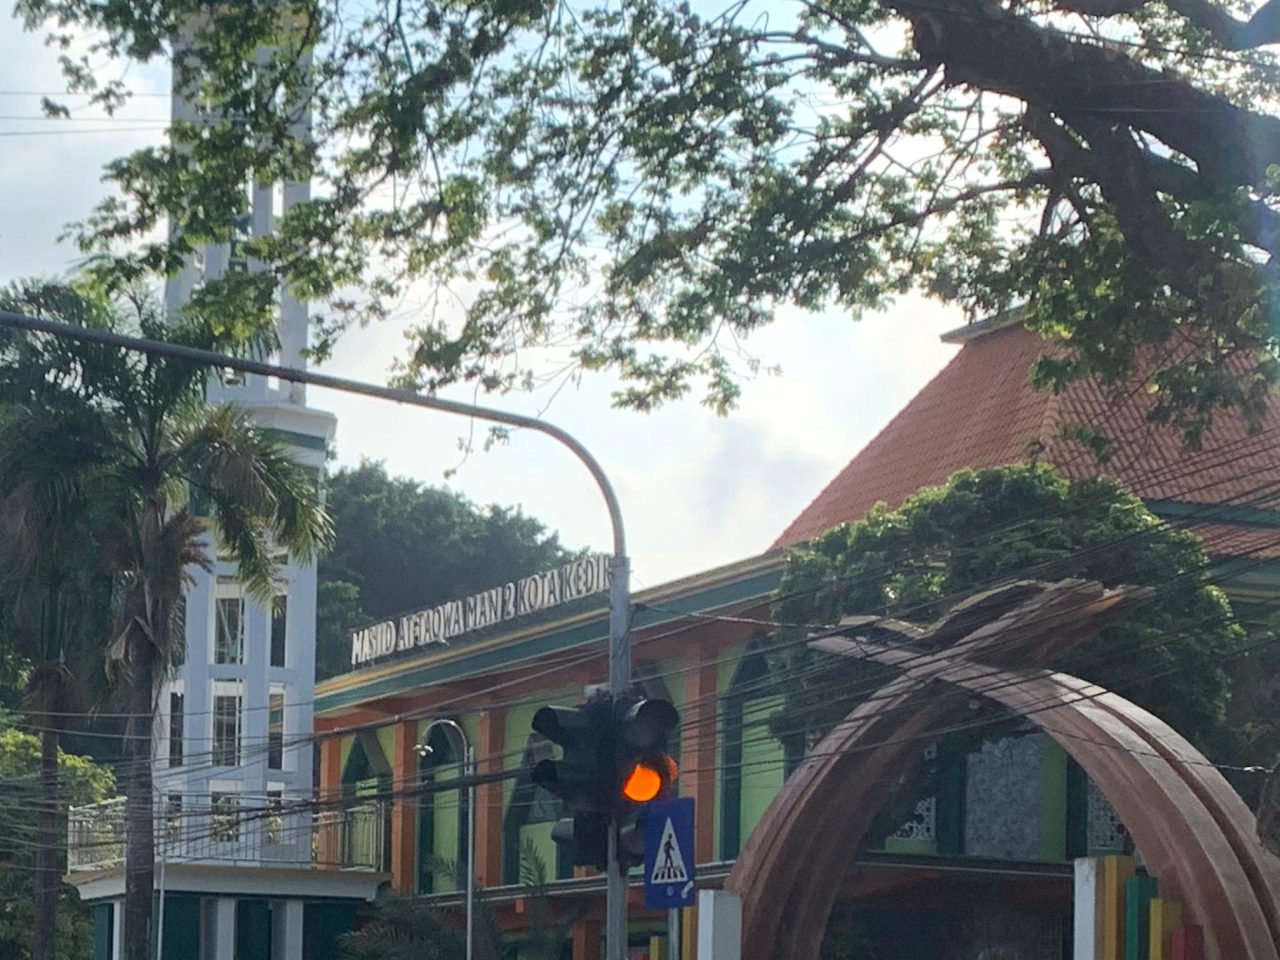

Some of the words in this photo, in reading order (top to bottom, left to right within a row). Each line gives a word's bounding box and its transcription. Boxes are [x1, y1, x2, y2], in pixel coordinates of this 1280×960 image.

[465, 586, 503, 632] MAN
[504, 581, 516, 620] 2
[517, 569, 562, 616] KOTA
[562, 554, 613, 602] KEDIR
